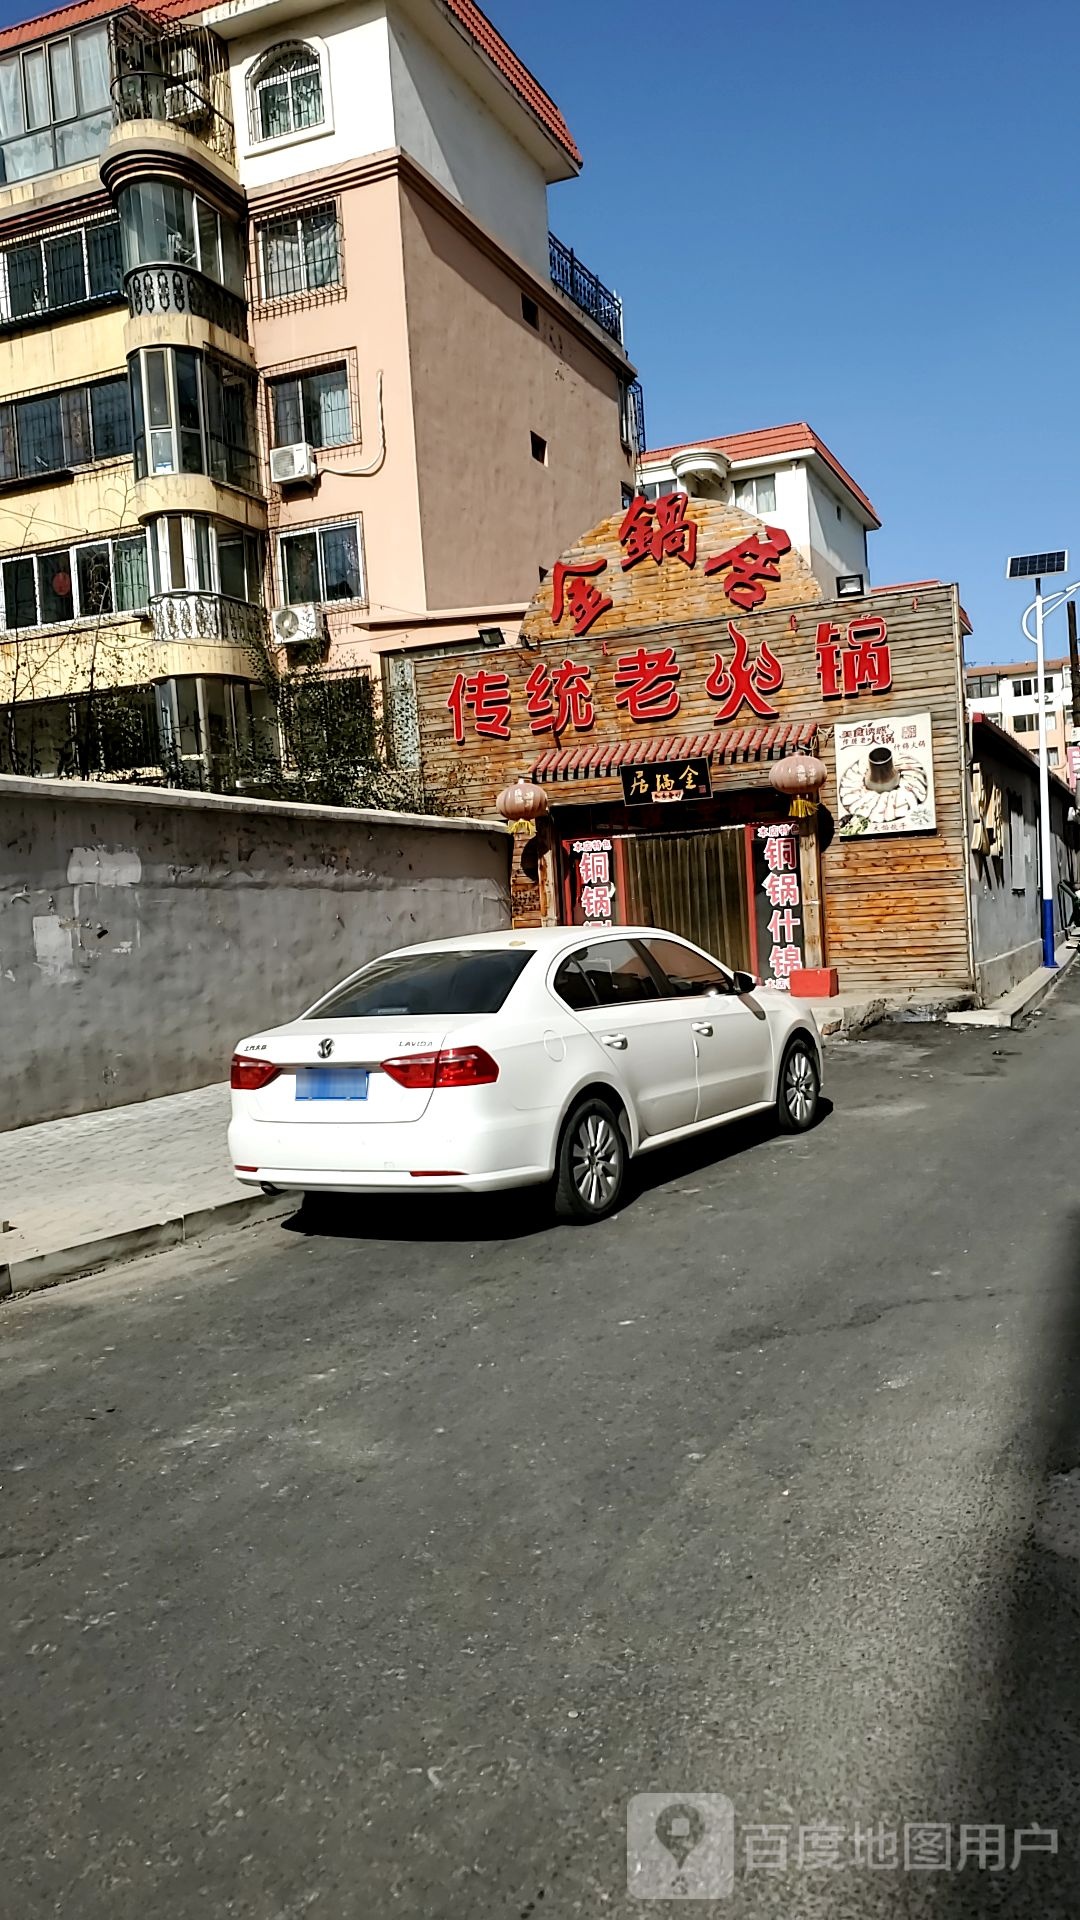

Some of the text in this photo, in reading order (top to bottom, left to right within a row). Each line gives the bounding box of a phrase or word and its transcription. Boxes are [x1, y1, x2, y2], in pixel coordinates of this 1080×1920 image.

[447, 615, 893, 743] 传统老火锅
[573, 839, 612, 852] 本店特色
[758, 824, 799, 838] 本店特色
[579, 852, 613, 927] 铜锅
